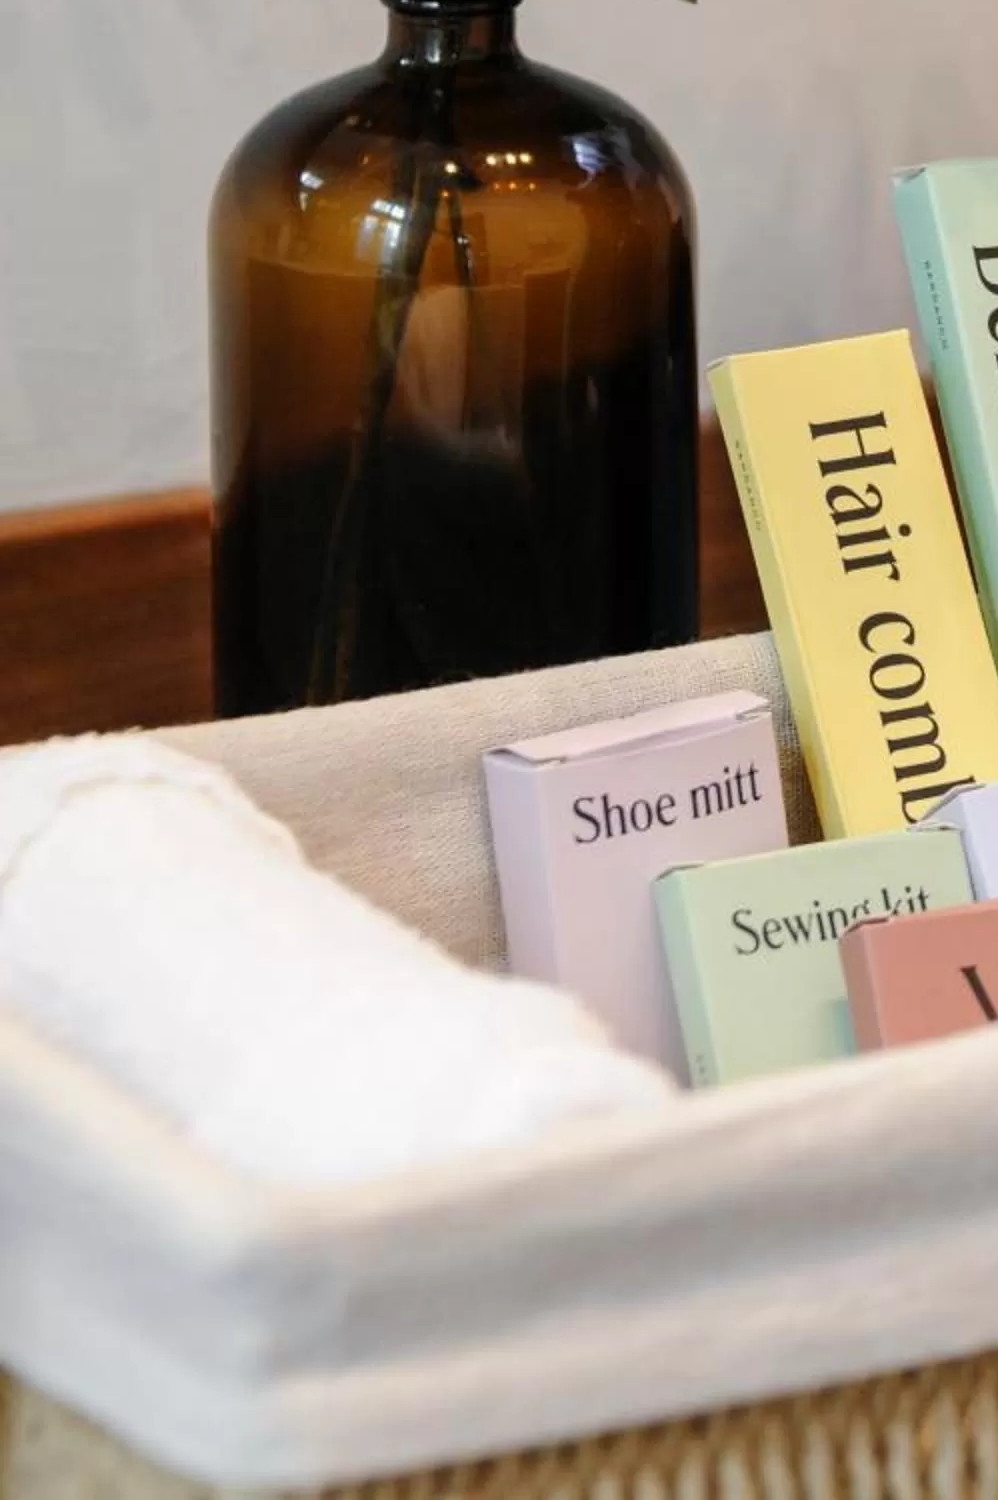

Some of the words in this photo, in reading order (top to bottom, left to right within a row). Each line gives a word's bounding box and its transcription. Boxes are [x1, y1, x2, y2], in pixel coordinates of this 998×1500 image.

[808, 411, 912, 581] Hair
[573, 792, 677, 843] Shoe
[690, 761, 762, 819] mitt
